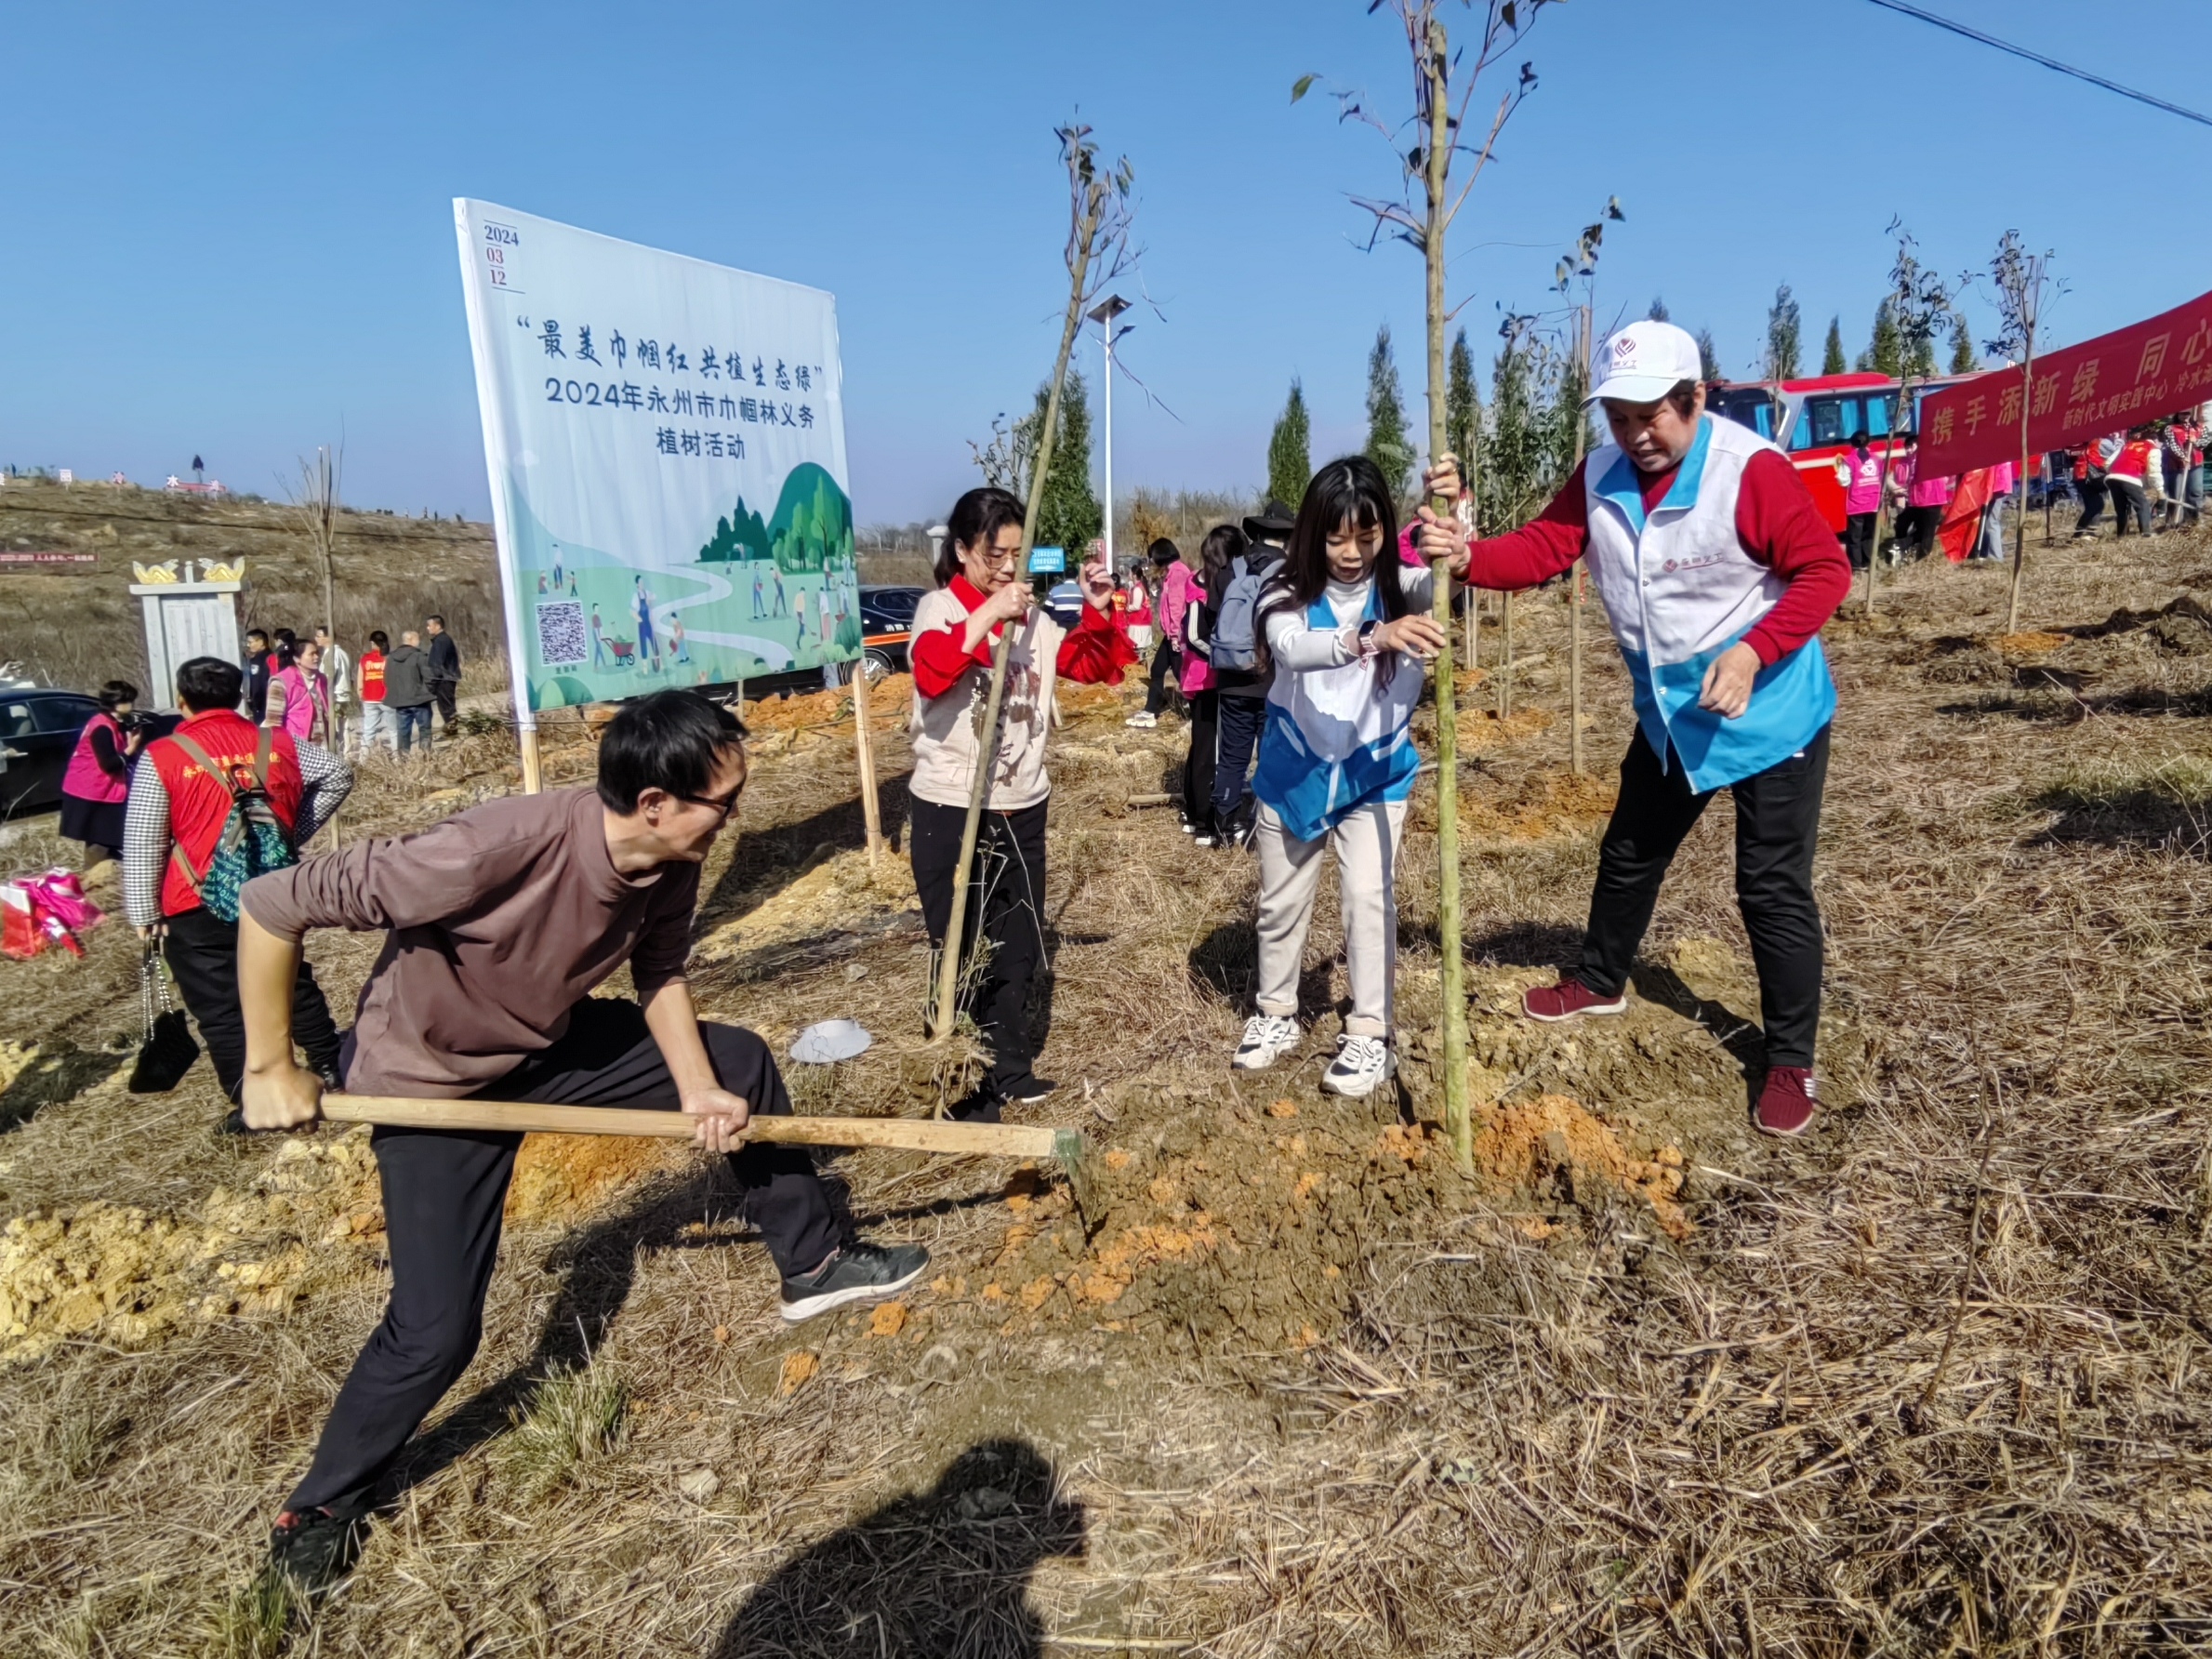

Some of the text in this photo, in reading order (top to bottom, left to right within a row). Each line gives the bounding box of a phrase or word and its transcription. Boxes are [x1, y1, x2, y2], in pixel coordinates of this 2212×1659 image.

[484, 225, 519, 246] 2024
[486, 247, 504, 264] 03
[489, 269, 508, 285] 12
[545, 378, 815, 429] 2024年永州市巾帼林义务
[1932, 359, 2099, 446] 携手添新绿
[2062, 379, 2167, 431] 新时代文明实践中心
[656, 427, 745, 459] 植树活动
